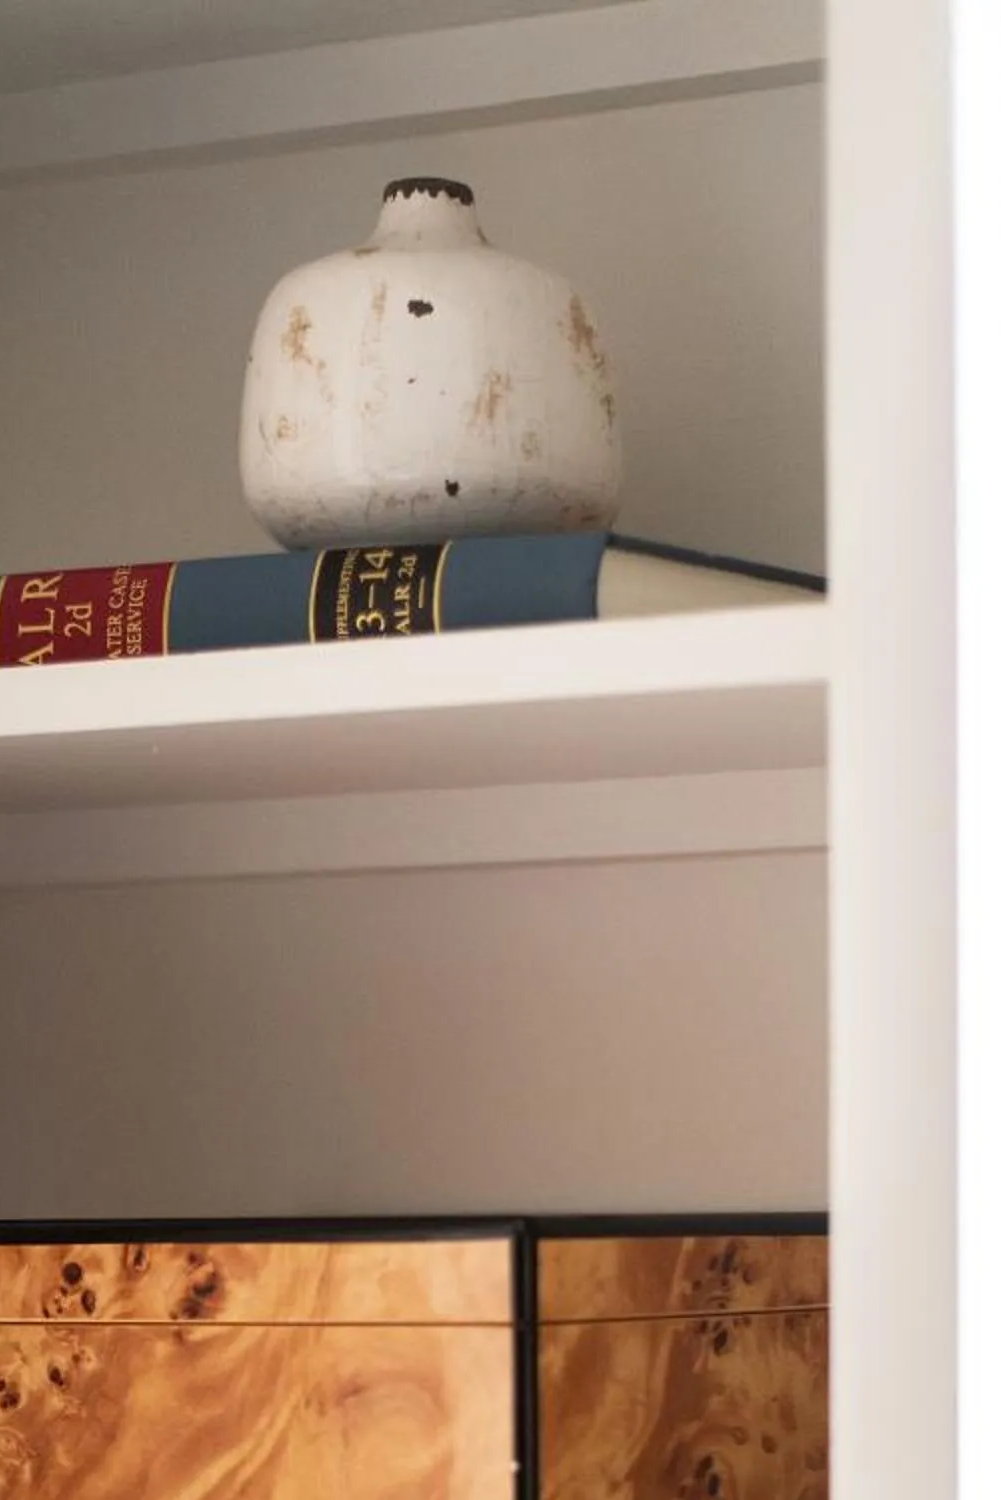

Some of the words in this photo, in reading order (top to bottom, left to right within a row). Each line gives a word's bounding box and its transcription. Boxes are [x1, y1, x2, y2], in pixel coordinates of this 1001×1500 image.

[398, 553, 417, 578] 2d
[18, 572, 64, 665] ALR
[126, 579, 148, 655] SERVICE
[356, 549, 394, 637] 3–14
[394, 584, 412, 635] ALR
[64, 601, 92, 637] 2d
[106, 613, 123, 660] ATER
